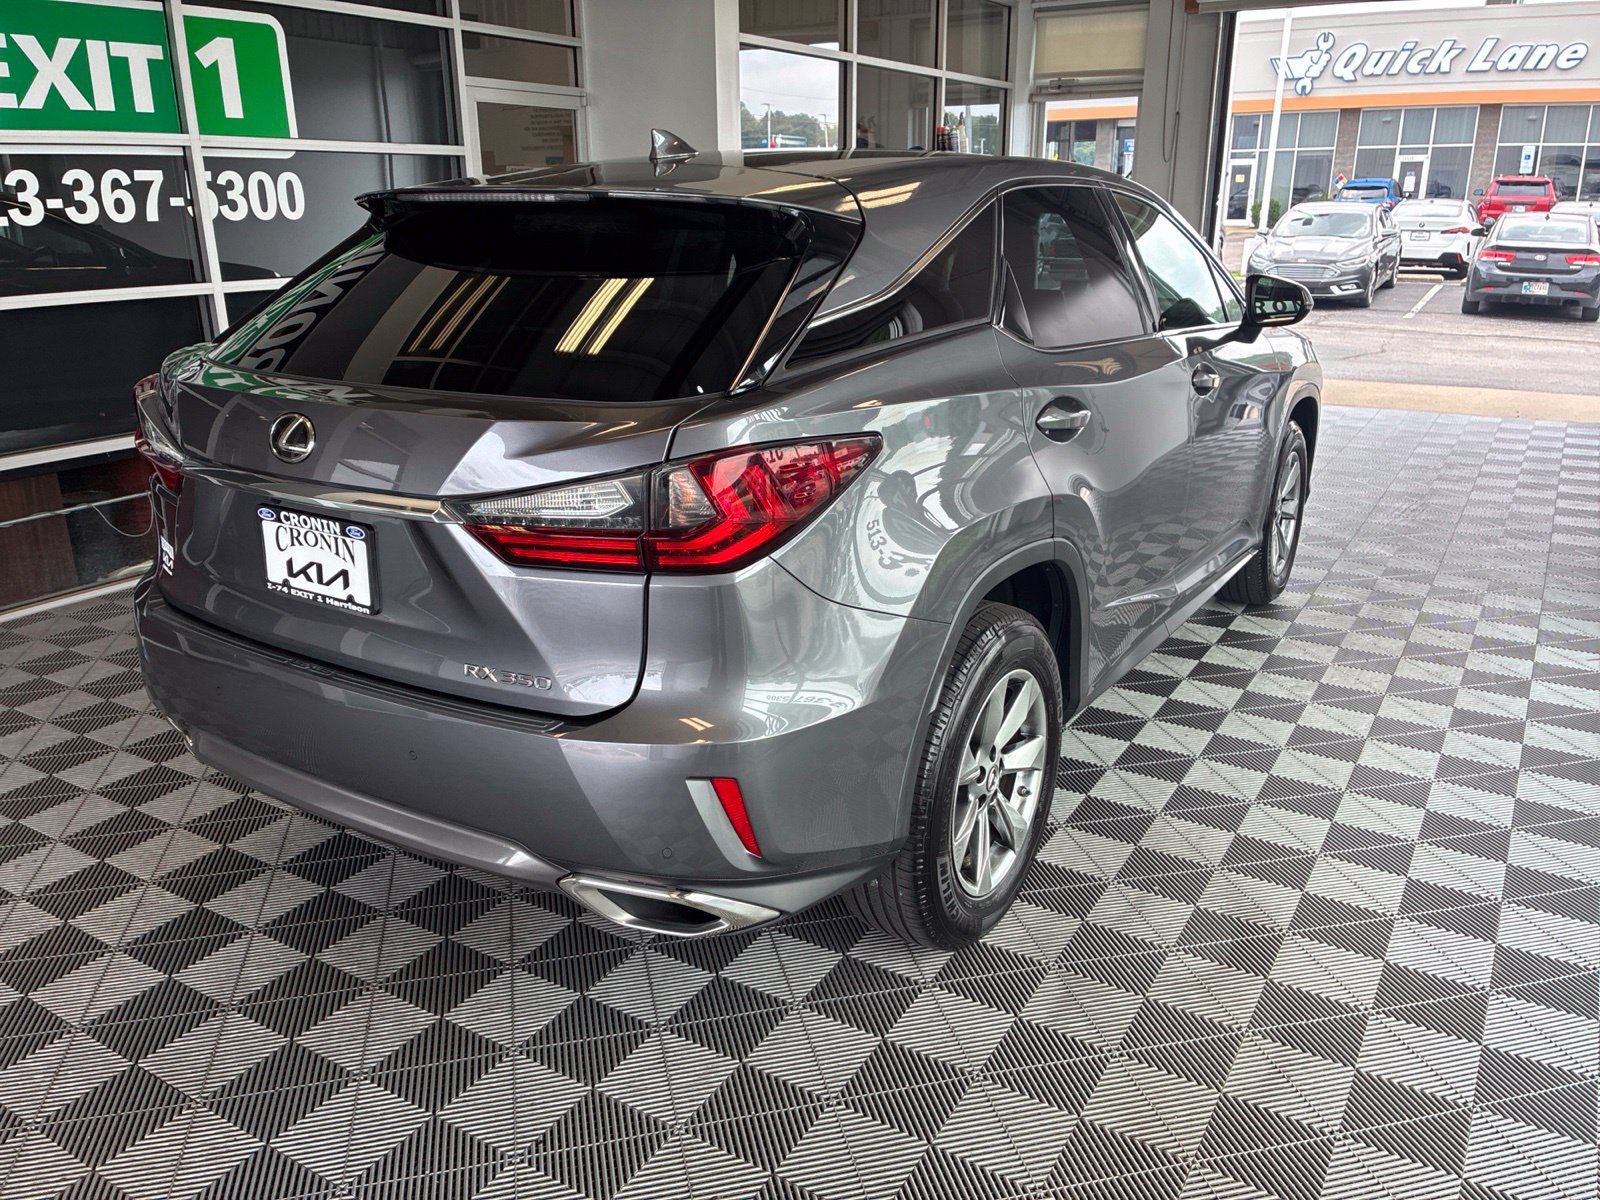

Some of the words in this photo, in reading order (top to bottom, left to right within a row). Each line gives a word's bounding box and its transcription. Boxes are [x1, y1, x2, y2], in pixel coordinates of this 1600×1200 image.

[194, 37, 244, 118] 1
[1332, 39, 1466, 81] Quick
[1466, 37, 1589, 73] Lane
[0, 168, 305, 227] 3-367-300
[280, 511, 341, 535] CRONIN
[275, 525, 356, 568] CRONIN
[267, 582, 289, 593] I-74
[290, 588, 315, 600] EXIT
[316, 595, 324, 603] 1
[325, 597, 370, 615] Harrison
[463, 662, 498, 683] RX
[500, 669, 552, 691] 350
